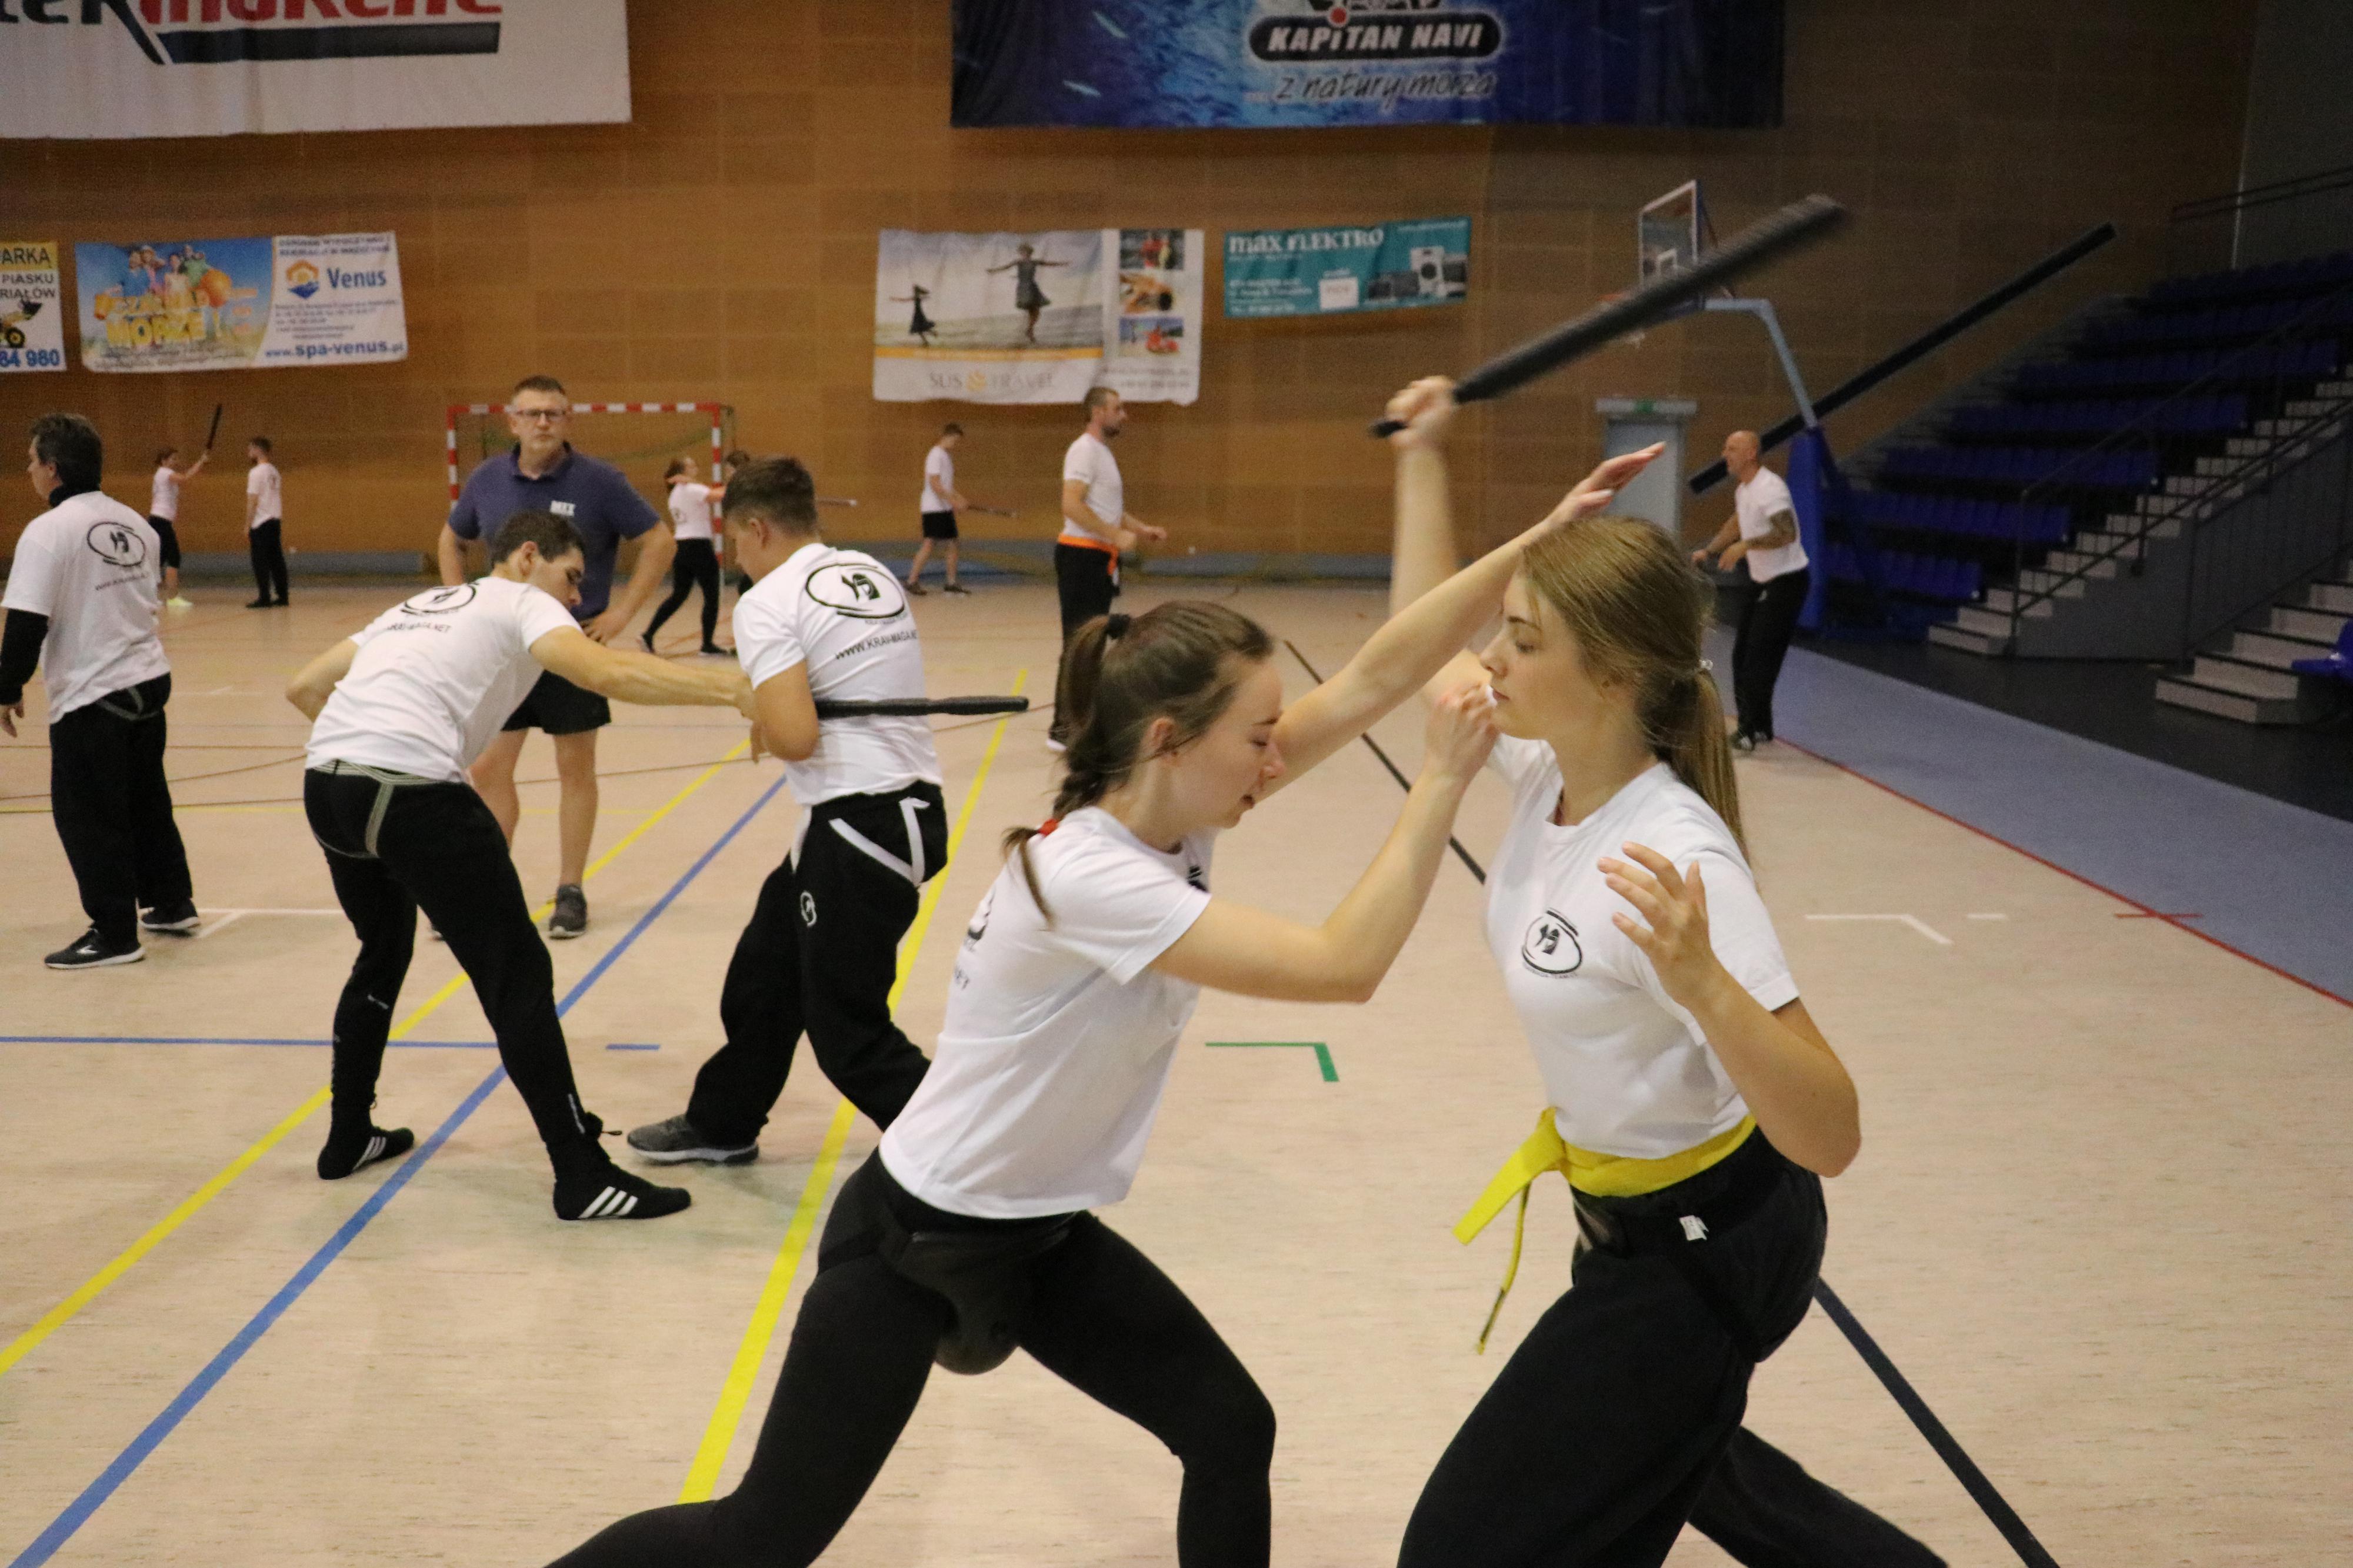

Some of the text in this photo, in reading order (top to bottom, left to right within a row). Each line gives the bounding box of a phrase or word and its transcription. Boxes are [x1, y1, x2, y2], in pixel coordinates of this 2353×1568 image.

[1411, 23, 1484, 48] NAVI
[1302, 70, 1399, 111] natury
[326, 266, 387, 289] Venus
[26, 348, 60, 367] 980
